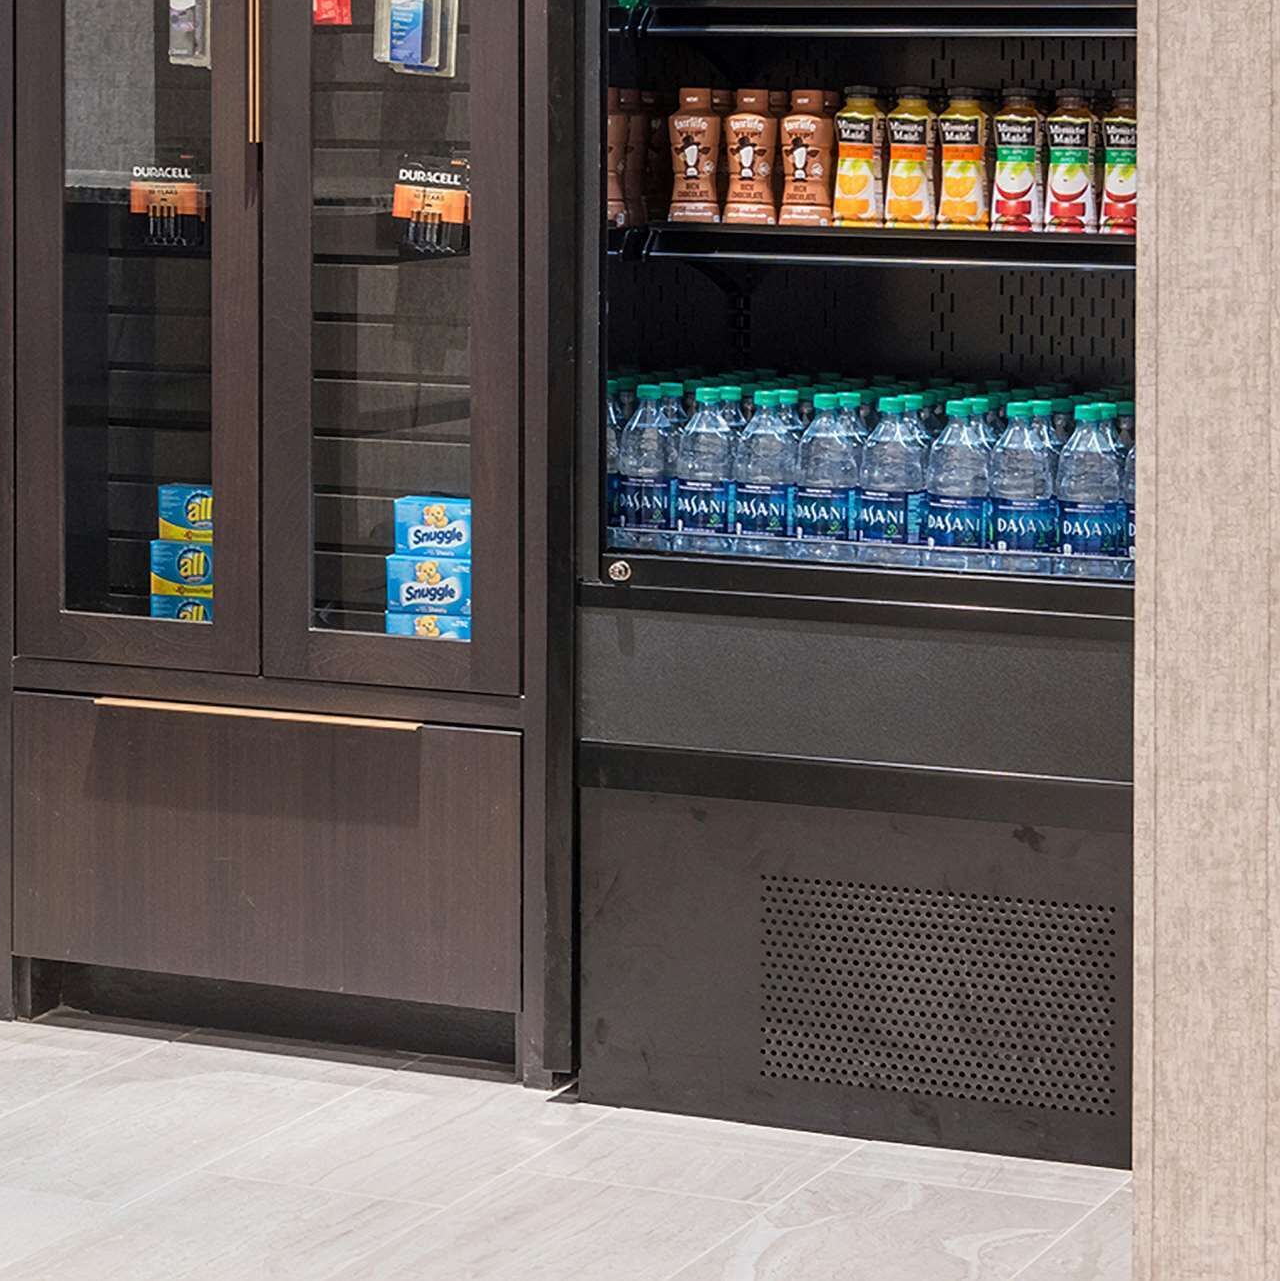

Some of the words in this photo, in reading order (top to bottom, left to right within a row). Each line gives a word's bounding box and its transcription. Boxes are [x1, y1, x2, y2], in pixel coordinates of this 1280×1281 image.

[132, 166, 192, 179] DURACELL
[398, 168, 462, 185] DURACELL
[678, 494, 726, 515] DASANI
[737, 497, 785, 519] DASANI
[795, 501, 846, 522] DASANI
[927, 512, 981, 533] DASANI
[412, 525, 464, 546] Snuggle
[178, 555, 205, 577] all
[405, 581, 456, 602] Snuggle
